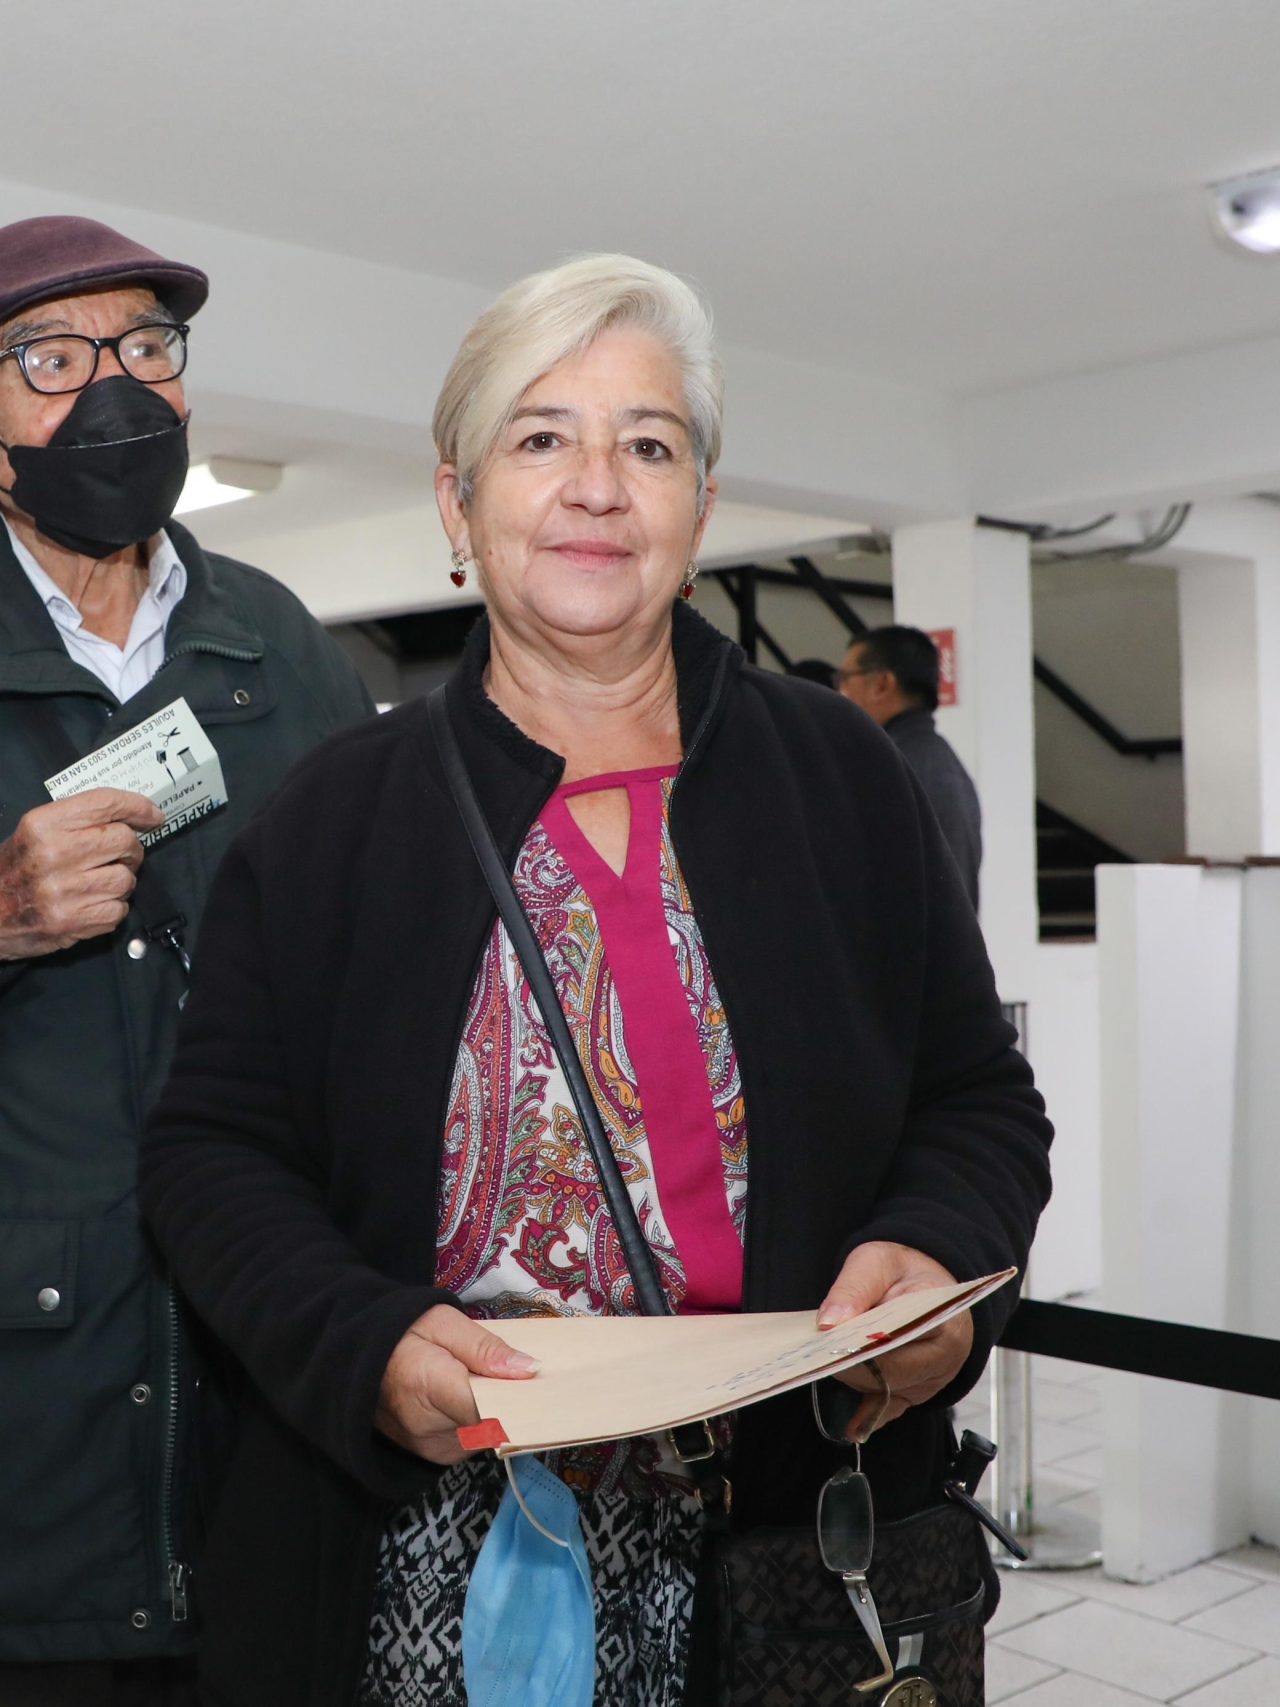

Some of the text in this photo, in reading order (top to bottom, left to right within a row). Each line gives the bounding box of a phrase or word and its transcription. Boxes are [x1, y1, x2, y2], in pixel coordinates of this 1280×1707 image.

[141, 709, 175, 734] AQUILES
[107, 729, 142, 755] SERDAN
[87, 750, 107, 767] 5303
[123, 741, 152, 763] Atendido
[69, 762, 88, 778] SAN
[97, 766, 110, 777] sus
[110, 757, 123, 769] por
[46, 774, 68, 791] BALT
[140, 798, 214, 848] PAPELERIA
